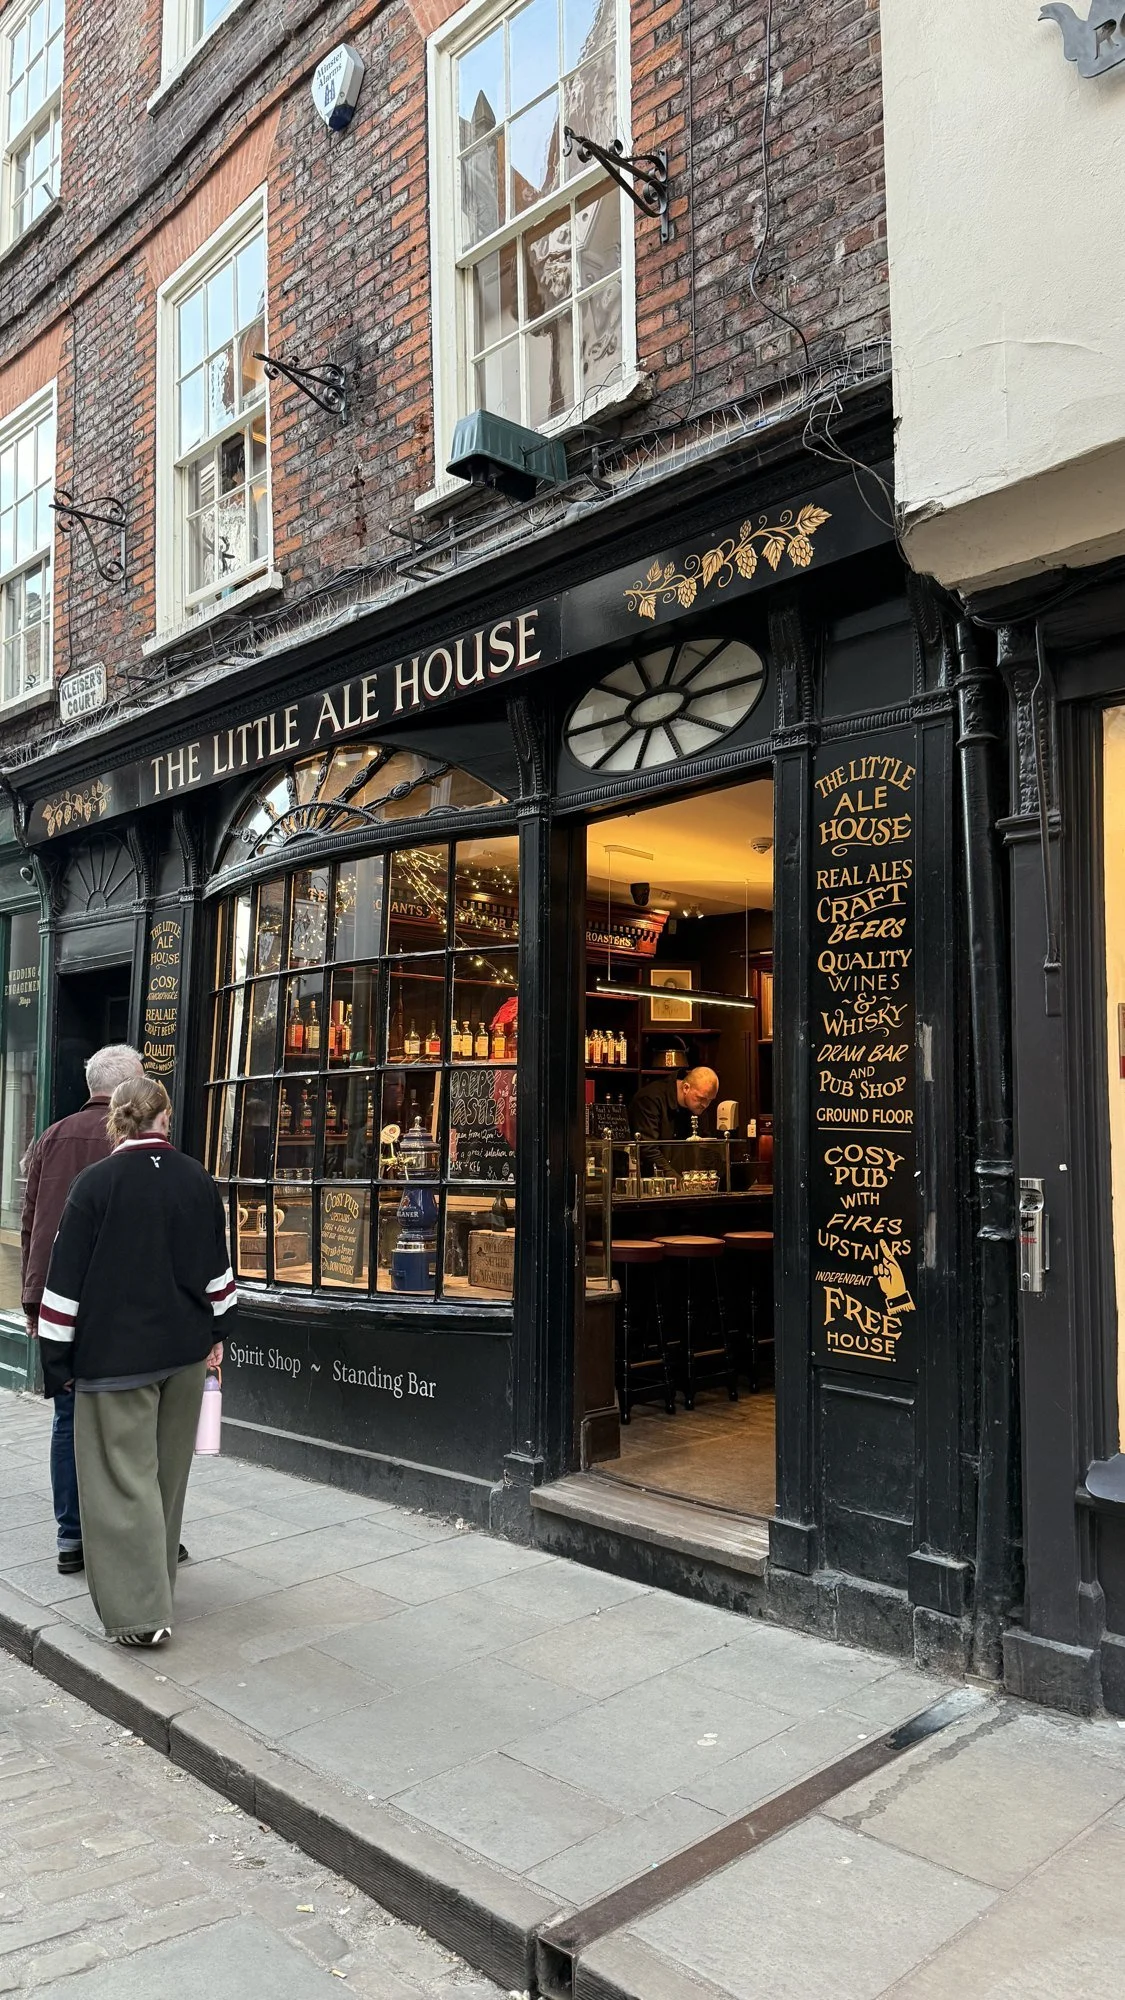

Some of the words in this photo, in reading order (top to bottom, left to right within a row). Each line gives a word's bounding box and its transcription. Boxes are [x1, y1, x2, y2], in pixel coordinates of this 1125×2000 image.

[316, 51, 343, 80] Minster
[318, 63, 342, 90] Alarms
[61, 669, 102, 701] KLEISER'S
[151, 743, 202, 796] THE
[212, 704, 301, 776] LITTLE
[313, 673, 380, 741] ALE
[393, 609, 542, 713] HOUSE
[814, 766, 849, 799] THE
[849, 755, 916, 791] LITTLE
[833, 785, 888, 816] ALE
[819, 812, 912, 847] HOUSE
[816, 867, 863, 890] REAL
[862, 859, 913, 885] ALES
[816, 882, 908, 924] CRAFT
[150, 923, 163, 941] THE
[163, 920, 182, 939] LITTLE
[156, 935, 174, 949] ALE
[586, 931, 633, 947] ROASTERS.
[827, 917, 907, 945] BEERS
[150, 951, 180, 966] HOUSE
[817, 948, 913, 977] QUALITY
[8, 966, 36, 981] WEDDING
[150, 975, 179, 991] COSY
[828, 973, 900, 992] WINES
[5, 980, 40, 996] ENGAGEMEN
[145, 1008, 163, 1021] REAL
[853, 992, 877, 1015] &
[144, 1022, 161, 1037] CRAFT
[820, 1002, 909, 1038] WHISKY
[817, 1044, 867, 1063] DRAM
[867, 1043, 909, 1062] BAR
[819, 1070, 854, 1097] PUB
[859, 1076, 907, 1099] SHOP
[849, 1066, 875, 1079] AND
[816, 1107, 869, 1124] GROUND
[872, 1108, 914, 1126] FLOOR
[824, 1143, 905, 1172] COSY
[834, 1166, 888, 1188] PUB
[324, 1191, 345, 1213] COSY
[344, 1193, 359, 1219] PUB
[840, 1192, 880, 1209] WITH
[826, 1213, 903, 1235] FIRES
[818, 1228, 912, 1261] UPSTAIRS
[815, 1270, 874, 1287] INDEPENDENT
[823, 1285, 902, 1340] FREE
[826, 1331, 896, 1355] HOUSE
[230, 1341, 264, 1368] Spirit
[268, 1349, 301, 1379] Shop
[332, 1360, 404, 1399] Standing
[408, 1372, 437, 1399] Bar
